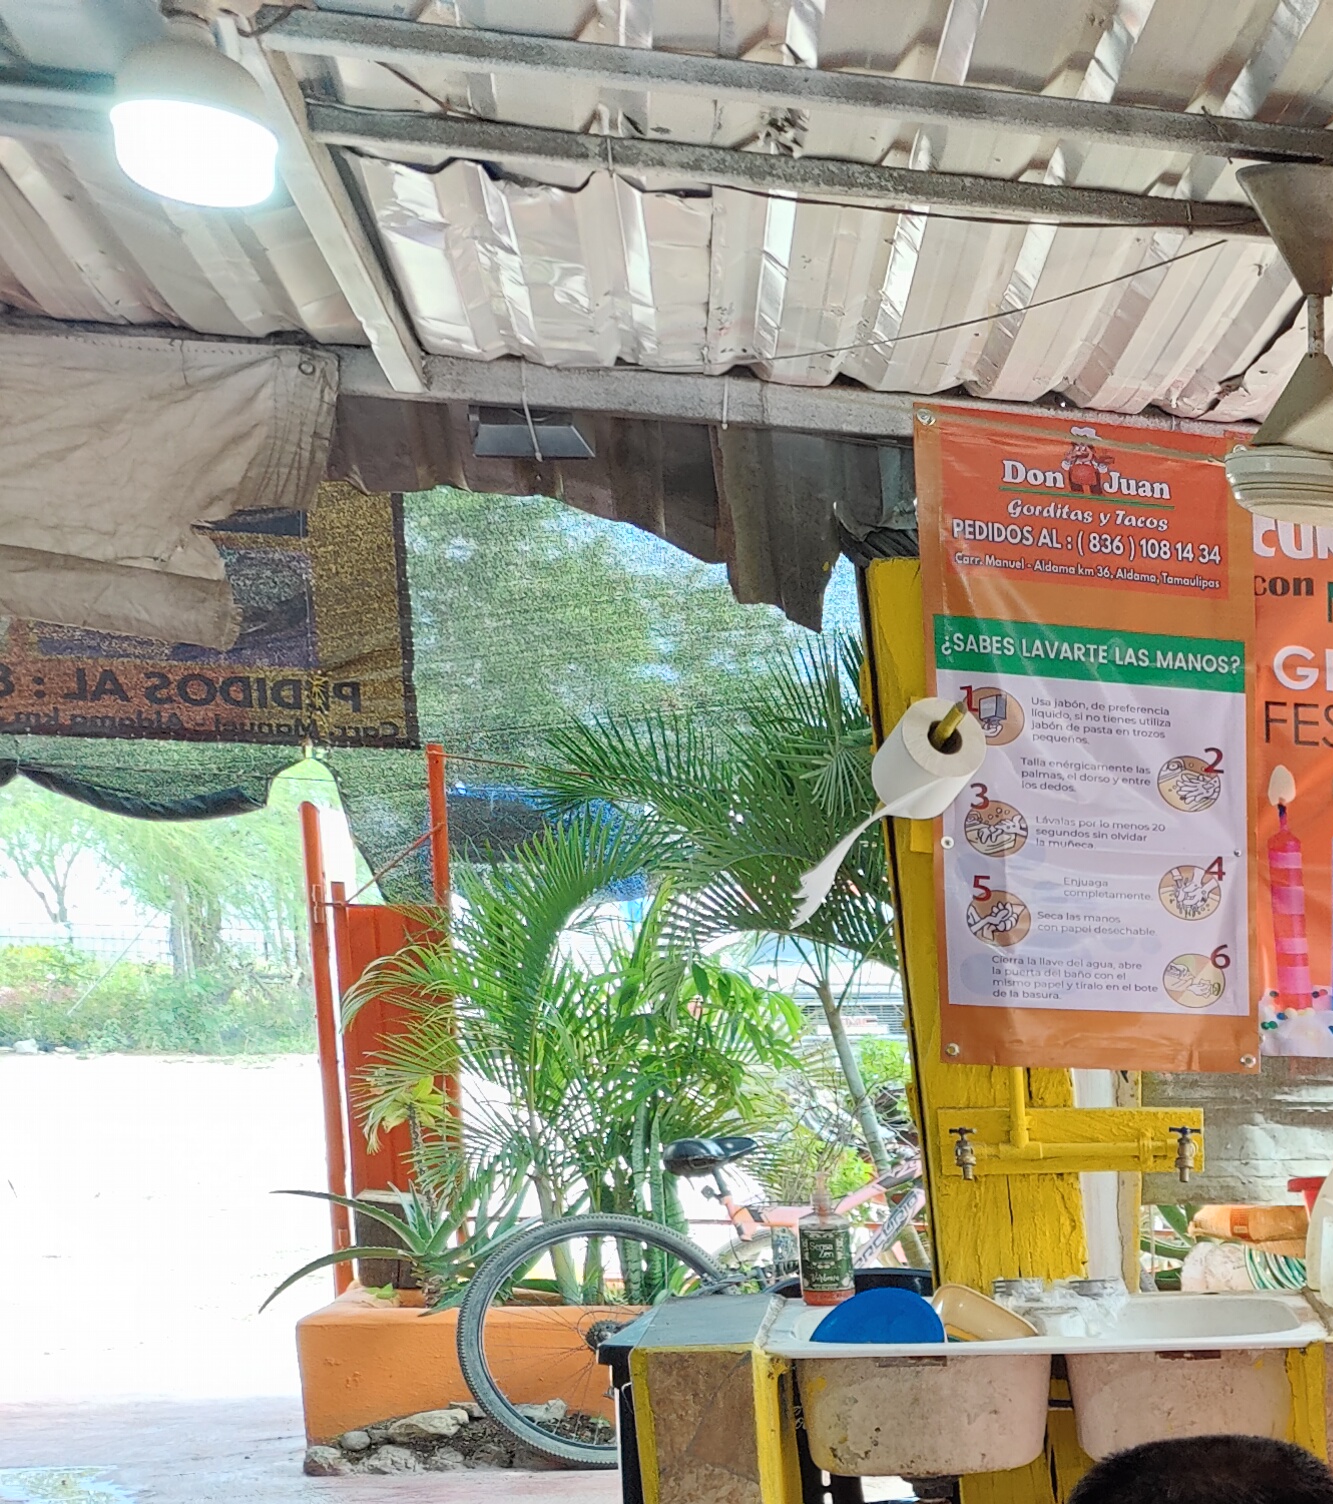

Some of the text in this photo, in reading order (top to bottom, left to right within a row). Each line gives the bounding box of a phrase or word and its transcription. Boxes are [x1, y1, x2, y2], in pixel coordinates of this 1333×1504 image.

[1001, 459, 1171, 500] Don Juan
[1007, 499, 1169, 531] Gorditas y Tacos
[952, 518, 1033, 547] PEDIDOS
[1139, 537, 1171, 562] 108
[1175, 542, 1194, 563] 14
[1198, 544, 1221, 565] 34
[956, 552, 983, 567] Carr.
[985, 554, 1024, 571] Manuel
[1033, 560, 1076, 576] Aldama
[1078, 562, 1094, 578] km
[1116, 567, 1159, 585] Aldama,
[1161, 571, 1221, 591] Tamaulipas
[1254, 575, 1315, 598] con
[941, 632, 1241, 675] ¿SABES LAVARTE LAS MANOS?
[1091, 701, 1106, 711] de
[1108, 703, 1170, 717] preferencia
[1031, 720, 1063, 733] jabón
[1066, 723, 1081, 733] de
[1083, 725, 1113, 738] pasta
[1132, 728, 1166, 739] trozos
[1086, 713, 1101, 722] no
[1139, 716, 1171, 728] utiliza
[1020, 757, 1046, 768] Talla
[1135, 765, 1151, 775] las
[1204, 747, 1224, 774] 2
[1021, 769, 1152, 788] palmas, dorso entre
[970, 783, 989, 810] 3
[1036, 828, 1091, 841] segundos
[1110, 831, 1147, 843] olvidar
[1112, 821, 1150, 832] menos
[1151, 823, 1166, 834] 20
[1204, 856, 1226, 882] 4
[972, 875, 992, 901] 5
[1063, 877, 1109, 889] Enjuaga
[1037, 911, 1121, 924] Seca las manos
[1037, 924, 1059, 933] con
[1061, 924, 1092, 937] papel
[991, 955, 1025, 966] Cierra
[1039, 957, 1064, 968] llave
[1066, 959, 1083, 968] del
[1118, 961, 1143, 971] abre
[1210, 944, 1231, 970] 6
[992, 978, 1032, 989] mismo
[1034, 980, 1064, 991] papel
[1106, 984, 1120, 992] en
[1134, 984, 1159, 994] bote
[1094, 972, 1115, 981] con
[992, 988, 1008, 998] de
